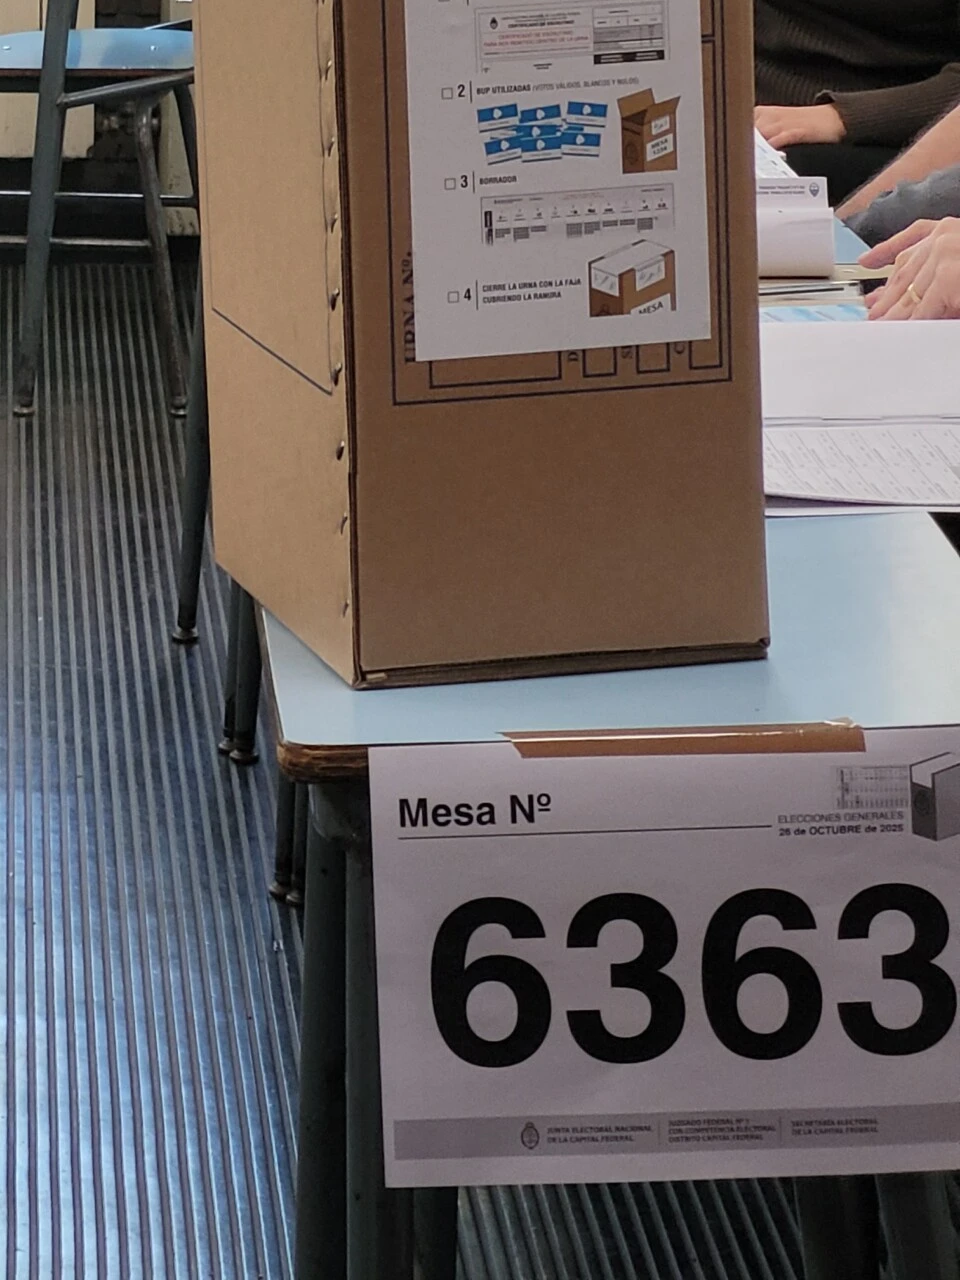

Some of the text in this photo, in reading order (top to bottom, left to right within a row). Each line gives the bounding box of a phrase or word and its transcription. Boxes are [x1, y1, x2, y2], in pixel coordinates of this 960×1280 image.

[457, 84, 466, 98] 2
[476, 86, 490, 96] BUP
[492, 84, 531, 94] UTILIZADAS
[460, 175, 468, 188] 3
[479, 176, 517, 185] BORRADOR
[482, 277, 581, 292] CIERRE LA URNA CON LA FAJA
[463, 288, 471, 301] 4
[482, 290, 562, 303] CUBRIENDO LA RAMURA
[638, 301, 664, 314] MESA
[397, 792, 552, 828] Mesa Nº
[778, 811, 904, 824] ELECCIONES GENERALES
[778, 823, 904, 837] 26 de OCTUBRE de 2025
[430, 882, 958, 1069] 6363
